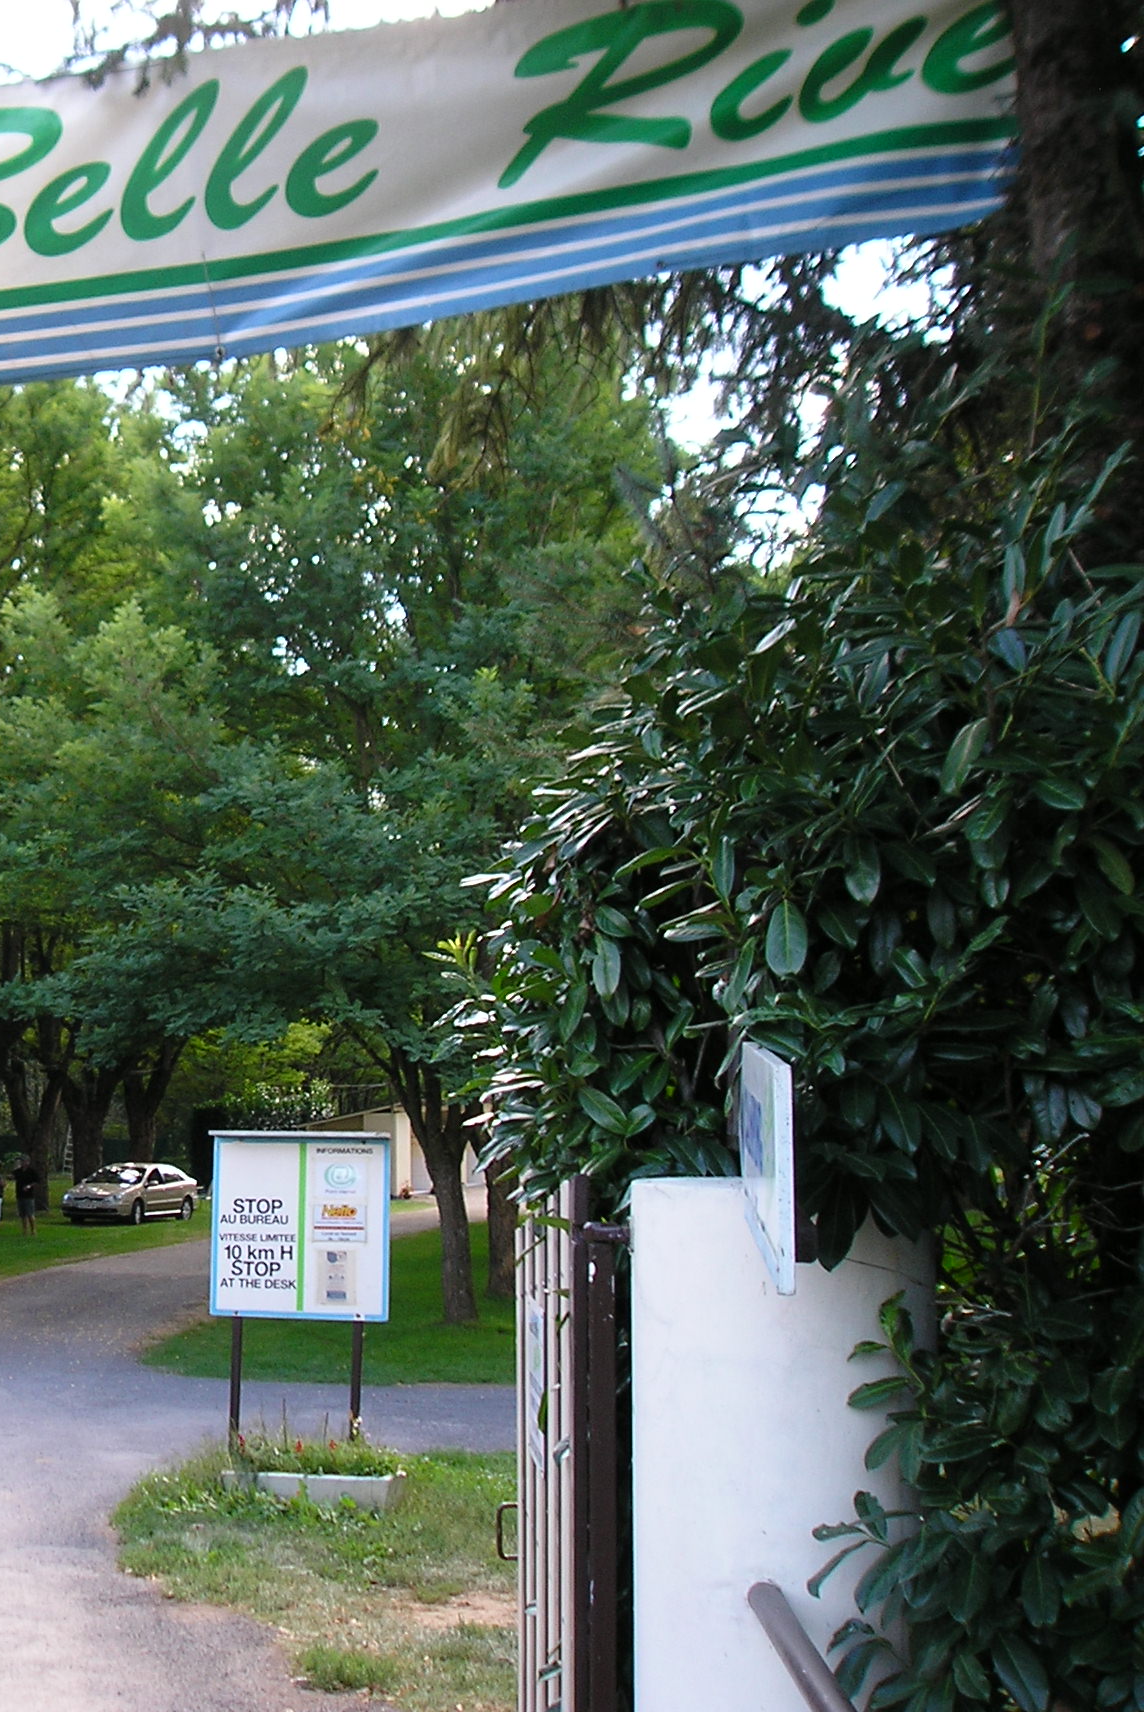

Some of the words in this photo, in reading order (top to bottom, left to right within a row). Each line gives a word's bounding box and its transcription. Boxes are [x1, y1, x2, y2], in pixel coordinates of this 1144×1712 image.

[233, 1198, 283, 1214] STOP
[220, 1214, 237, 1224] AU
[239, 1214, 289, 1225] BUREAU
[219, 1233, 257, 1242] VITESSE
[260, 1234, 296, 1242] LIMITEE
[224, 1245, 242, 1260] 10
[247, 1245, 275, 1260] km
[280, 1245, 293, 1260] H
[231, 1259, 281, 1276] STOP
[220, 1278, 235, 1288] AT
[238, 1278, 261, 1289] THE
[264, 1279, 297, 1290] DESK
